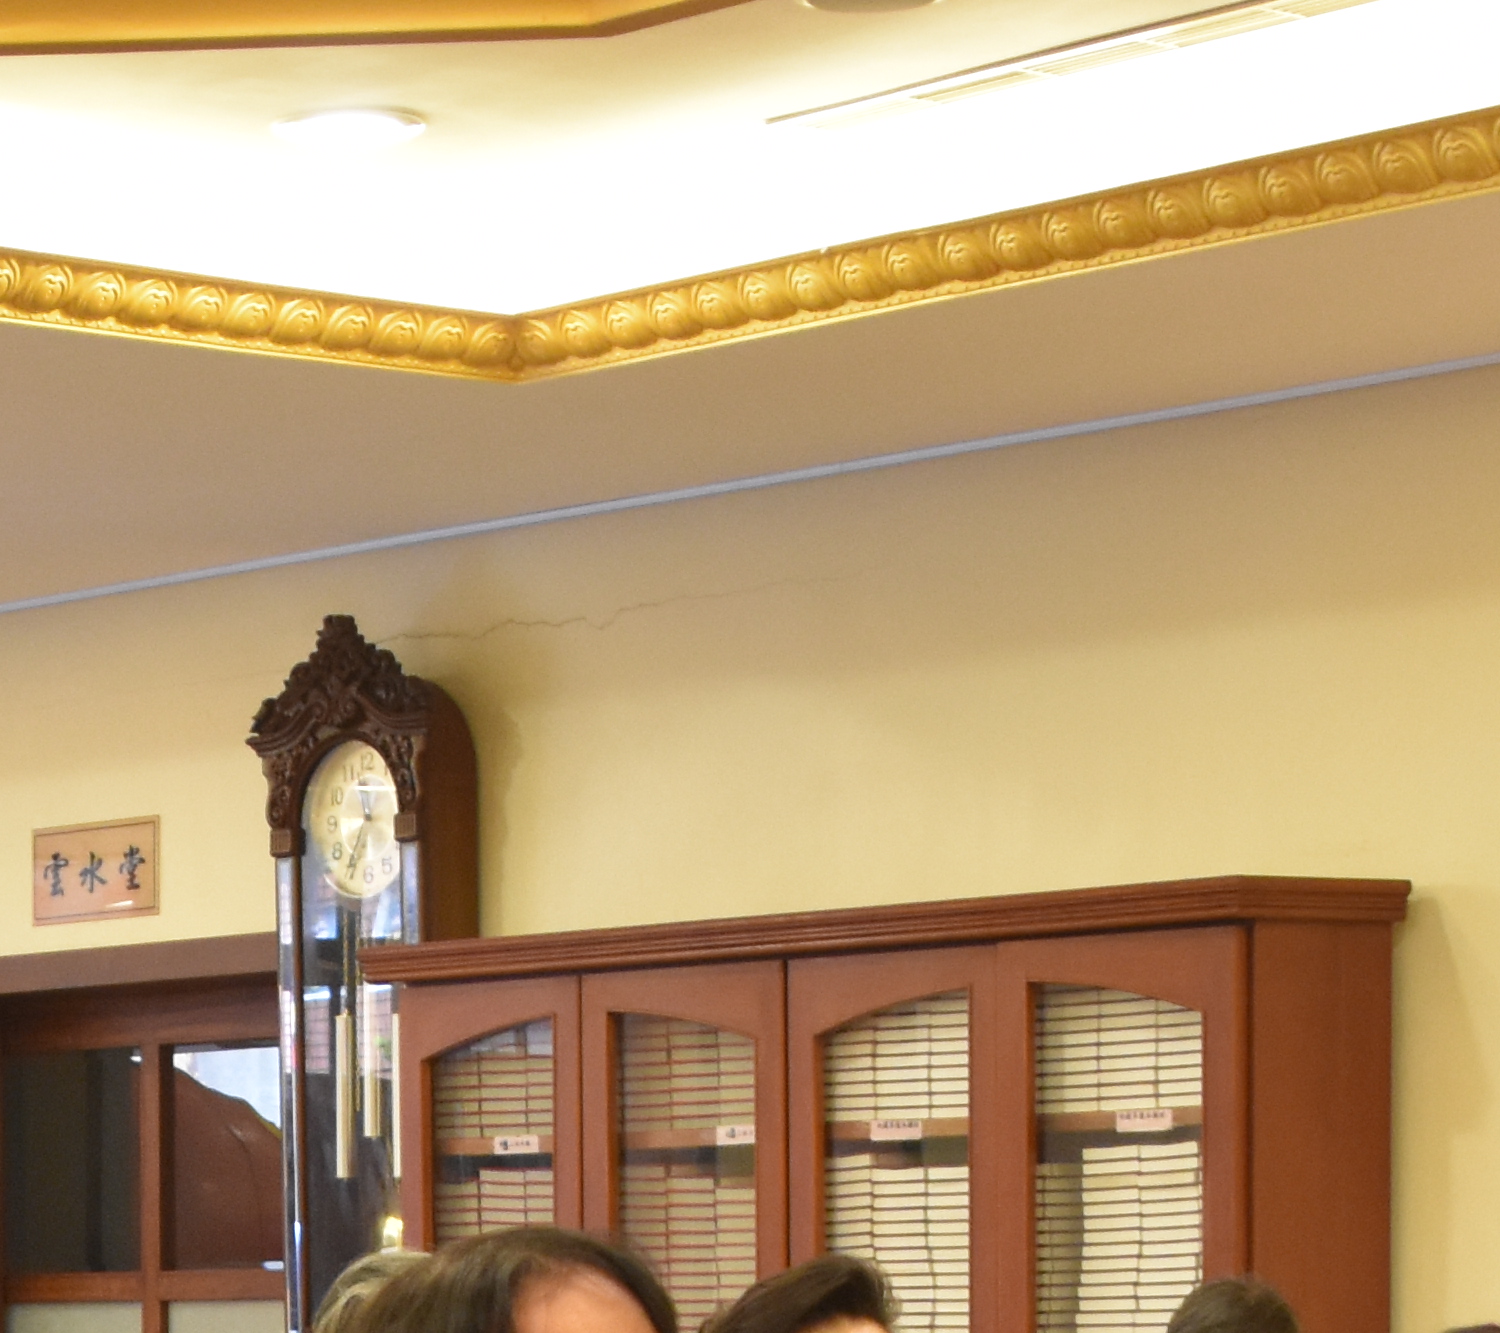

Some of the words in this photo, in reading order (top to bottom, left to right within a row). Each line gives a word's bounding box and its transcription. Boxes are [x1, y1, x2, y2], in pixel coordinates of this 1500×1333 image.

[361, 752, 374, 770] 12
[331, 787, 343, 806] 10
[327, 816, 337, 832] 9
[332, 842, 343, 860] 8
[363, 865, 373, 883] 6
[382, 856, 392, 875] 5
